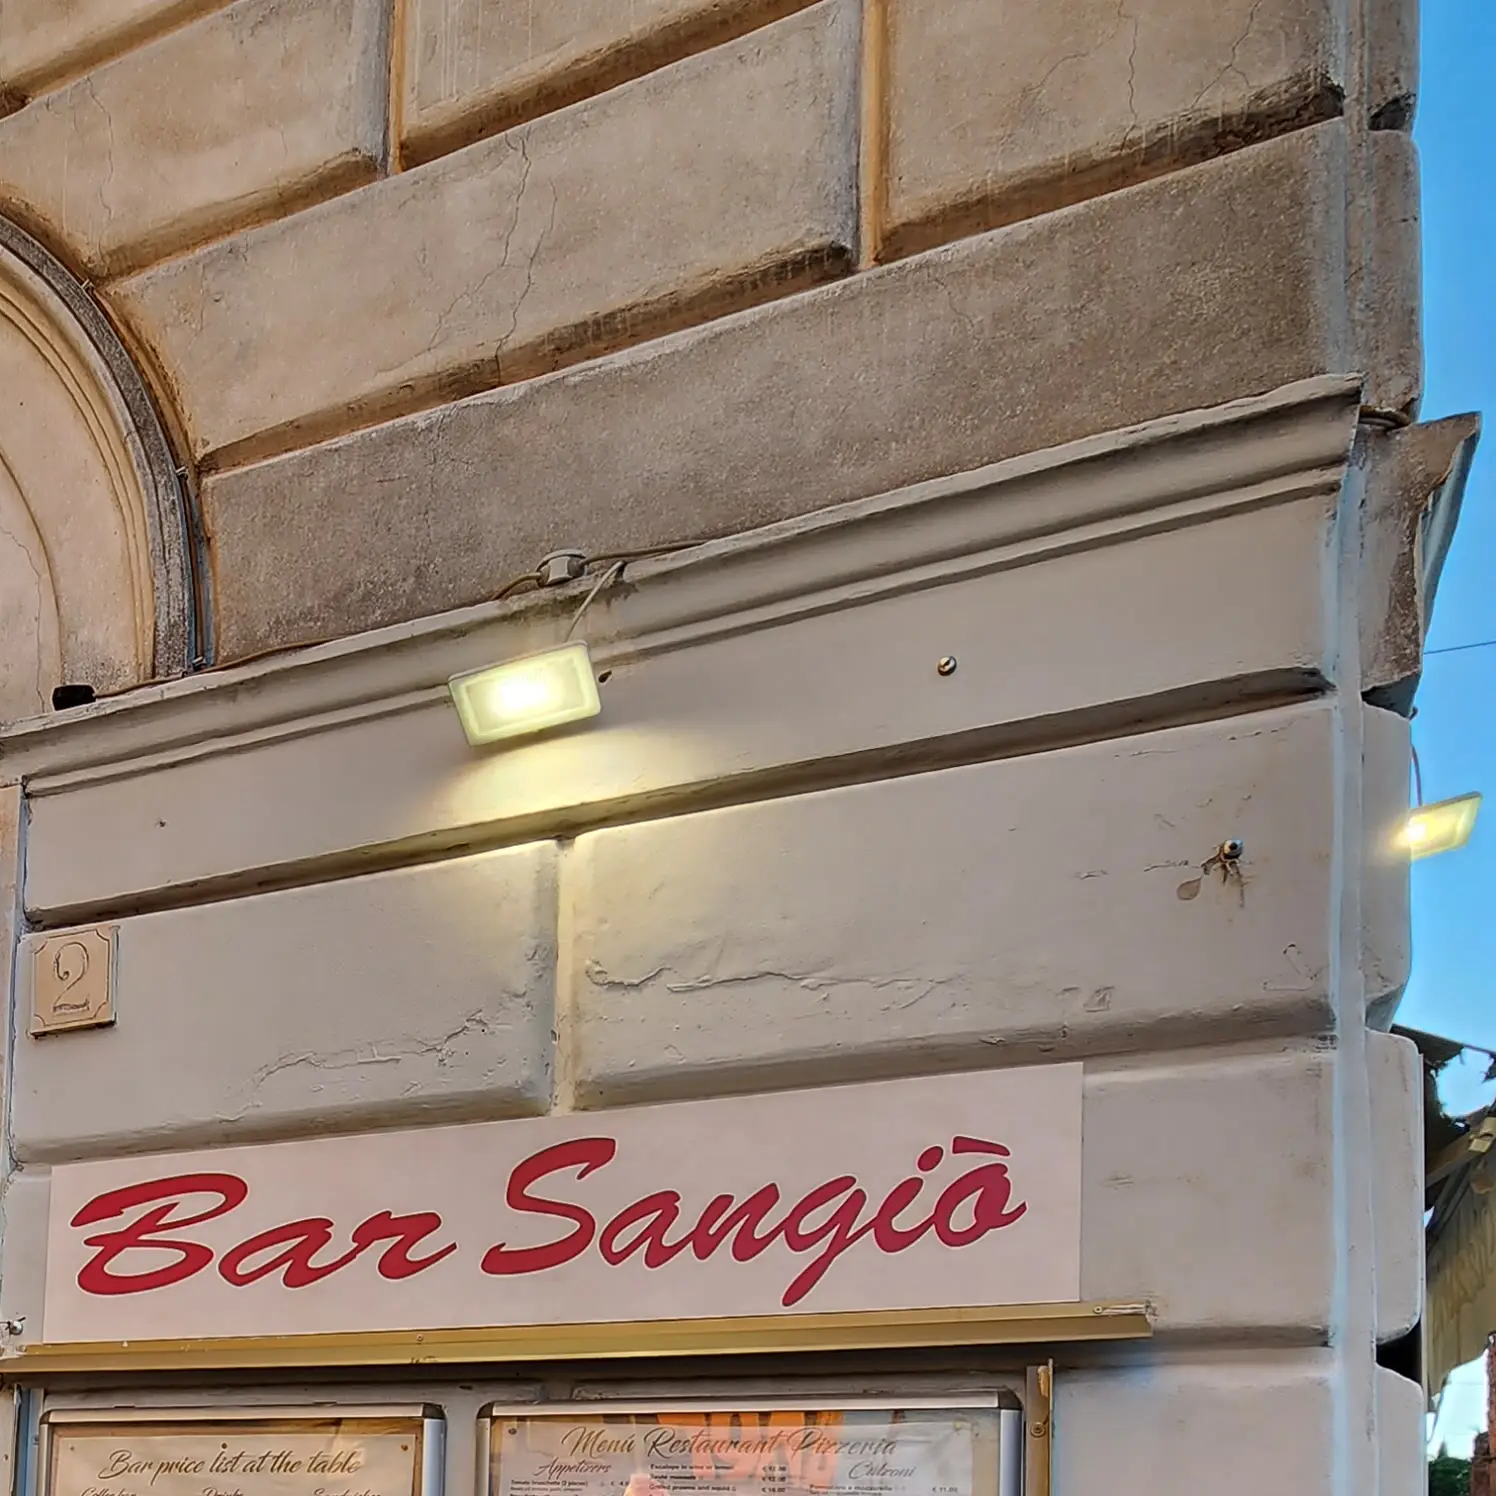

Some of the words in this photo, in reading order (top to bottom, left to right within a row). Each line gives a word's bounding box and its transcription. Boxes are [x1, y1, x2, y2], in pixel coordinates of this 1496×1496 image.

[53, 941, 89, 1012] 2
[70, 1173, 458, 1295] Bar
[480, 1136, 1027, 1306] Sangiò
[561, 1426, 636, 1459] Menú
[644, 1428, 785, 1459] Restaurant
[787, 1427, 897, 1462] Pizzeria
[98, 1449, 153, 1479] Bar
[150, 1457, 205, 1486] price
[209, 1450, 245, 1473] list
[242, 1451, 273, 1473] at
[270, 1451, 304, 1473] the
[306, 1451, 362, 1474] table
[534, 1457, 612, 1480] Appetizers
